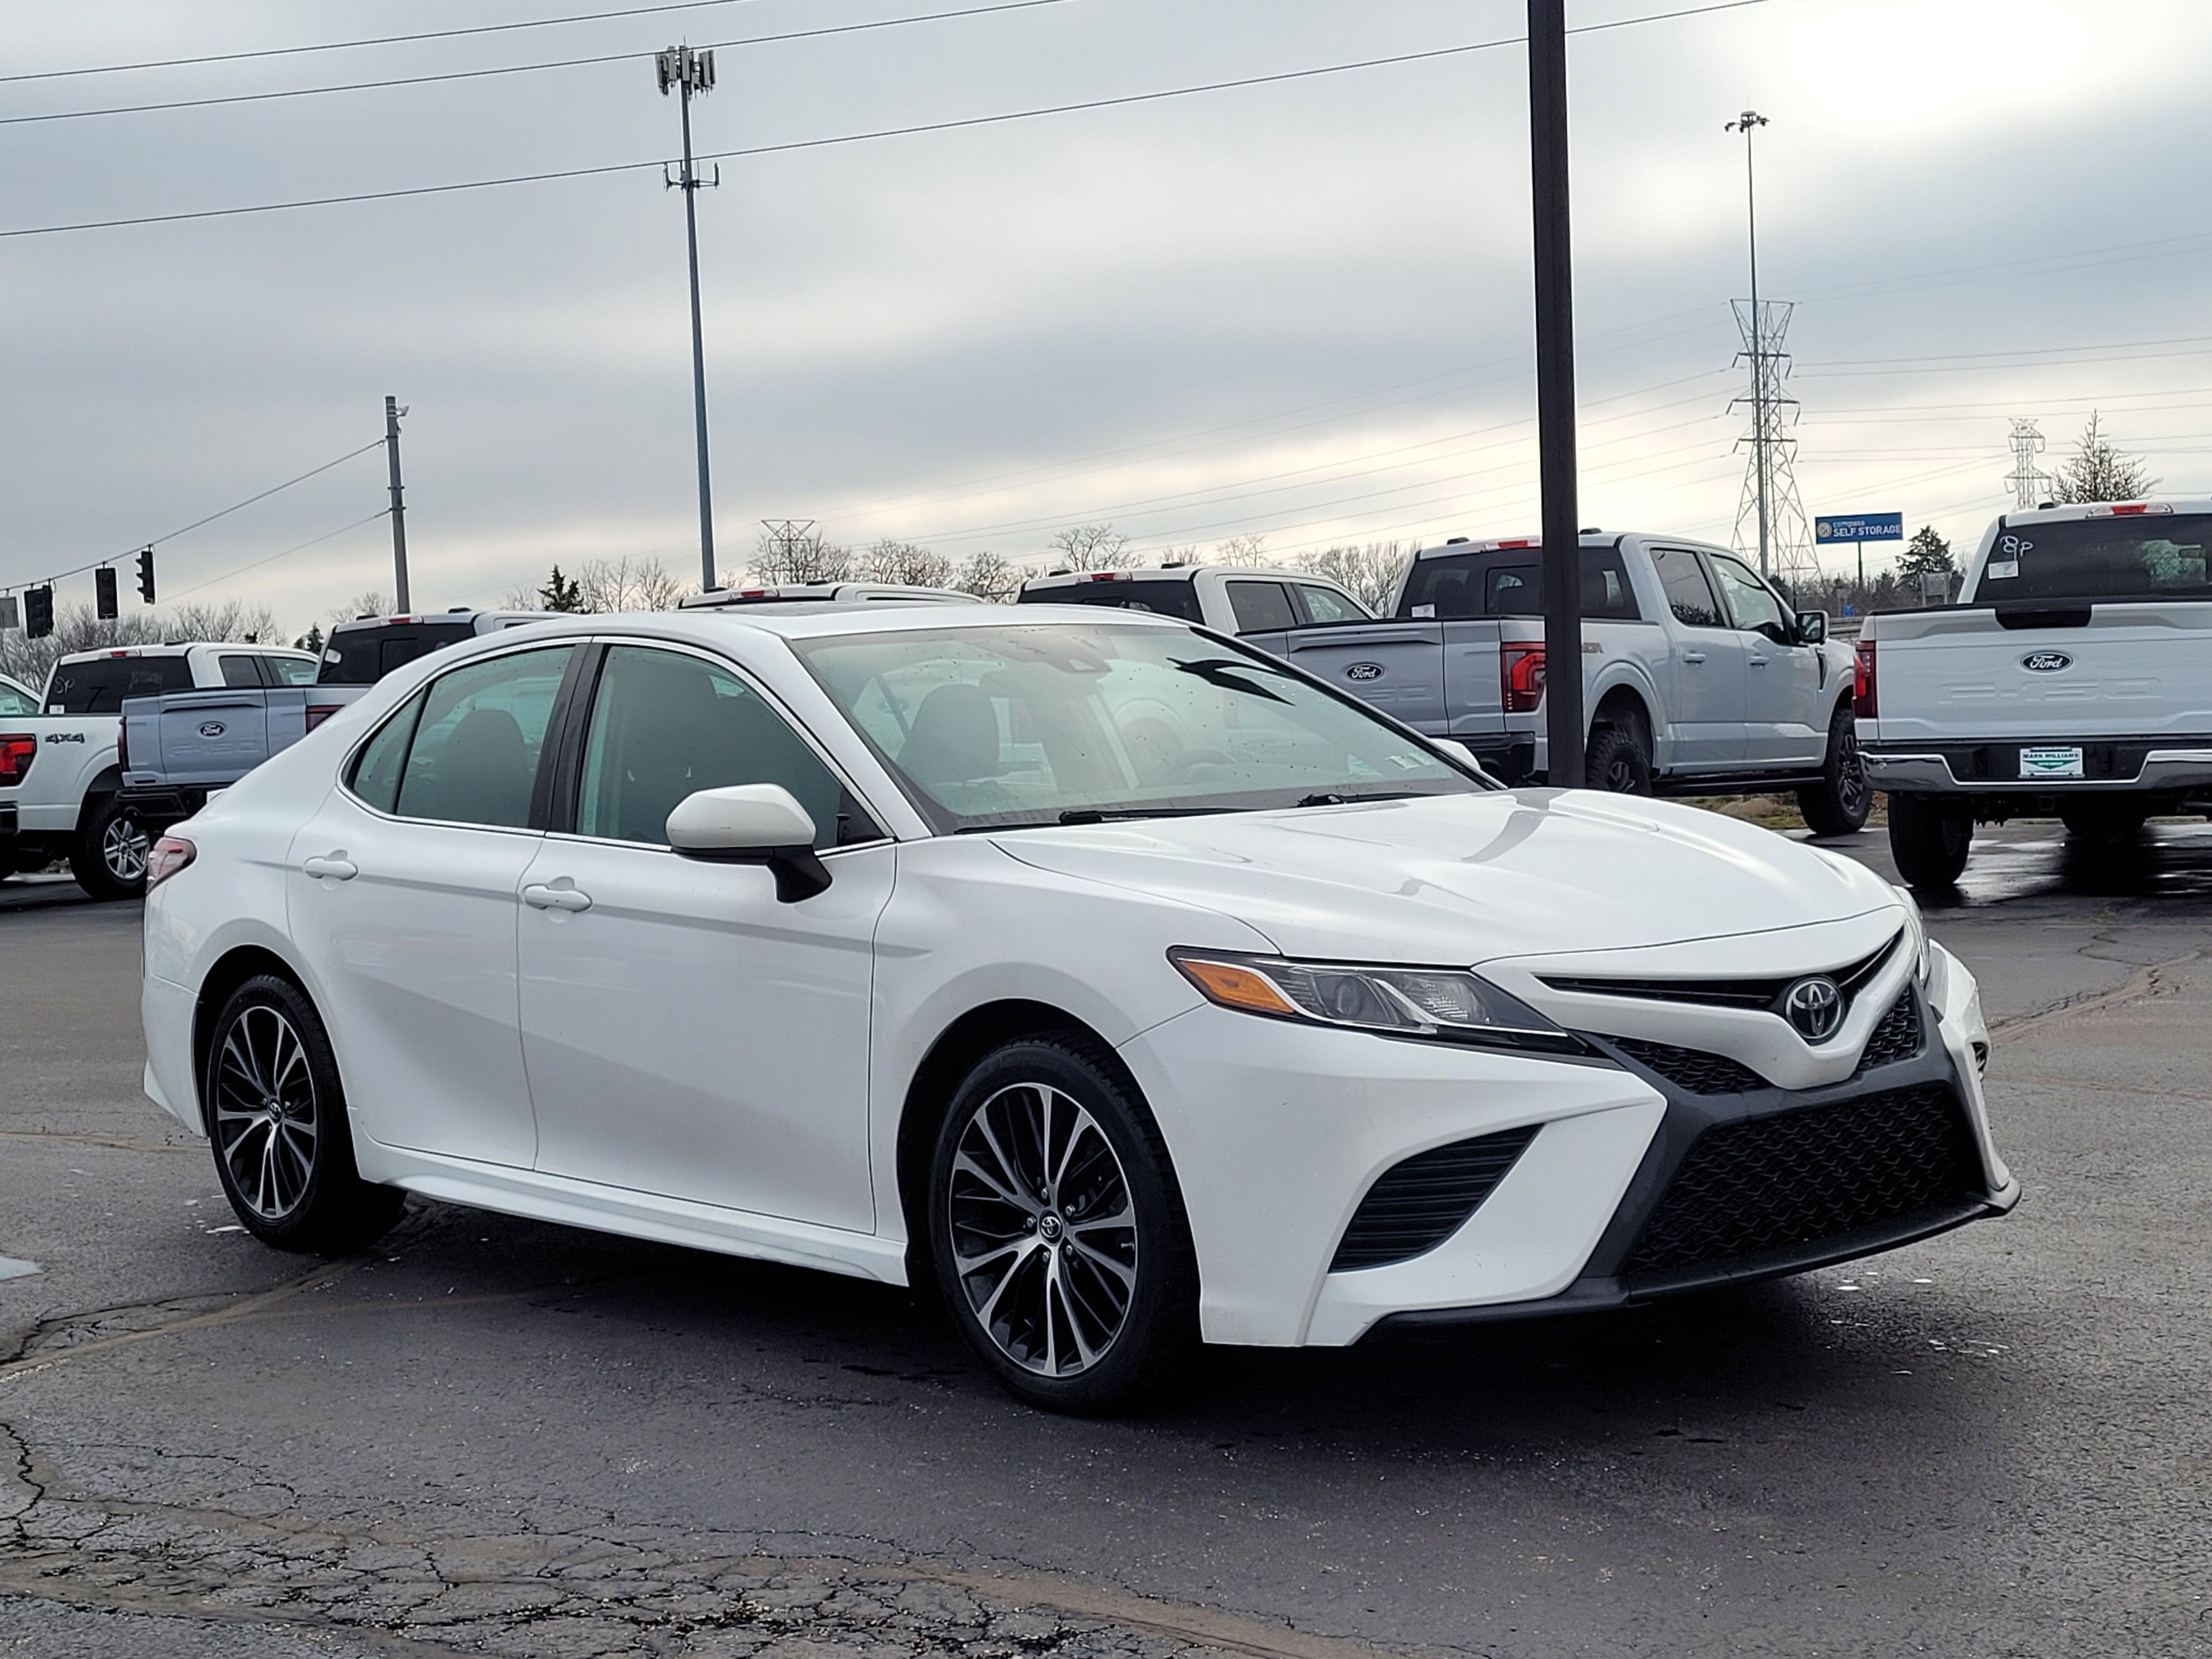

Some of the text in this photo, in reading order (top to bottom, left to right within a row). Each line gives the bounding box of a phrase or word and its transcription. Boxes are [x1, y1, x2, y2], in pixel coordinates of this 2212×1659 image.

[1833, 525, 1901, 537] SELF STORAGE
[2030, 655, 2063, 669] Ford
[1351, 667, 1375, 679] Ford
[202, 724, 221, 735] Ford
